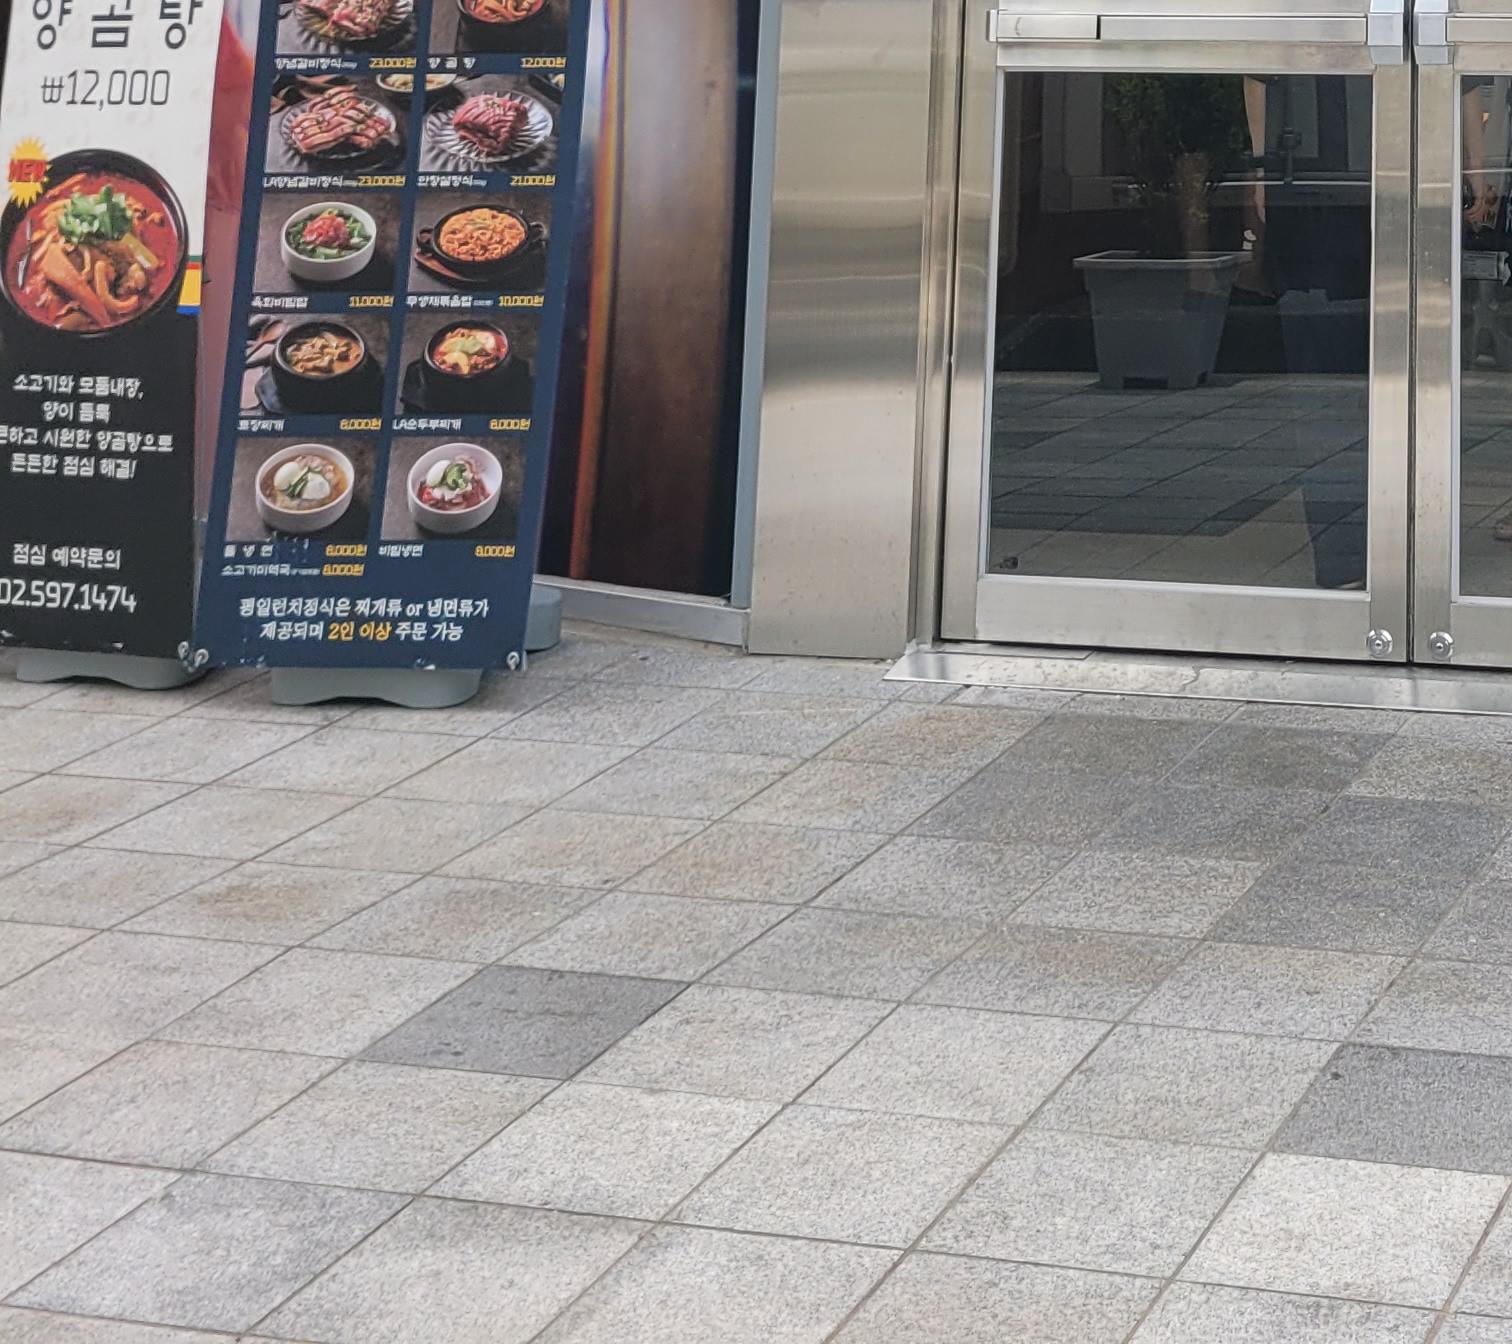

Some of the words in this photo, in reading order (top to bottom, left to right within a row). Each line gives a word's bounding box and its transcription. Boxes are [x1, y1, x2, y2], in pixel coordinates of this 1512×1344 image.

[13, 374, 75, 394] 소고기와
[42, 400, 74, 421] 양이
[42, 427, 92, 449] 시원한
[96, 431, 174, 453] 양곰탕으로
[11, 453, 59, 474] 든든한
[62, 456, 95, 477] 점심
[99, 458, 137, 480] 해결!
[13, 543, 47, 566] 점심
[51, 545, 122, 570] 예약문의
[0, 578, 137, 613] 02.597.1474
[239, 598, 351, 617] 평일런치정식은
[354, 598, 402, 616] 찌개류
[406, 603, 423, 616] or
[427, 598, 489, 618] 냉면류가
[260, 622, 322, 641] 제공되며
[328, 622, 355, 640] 2인
[358, 622, 392, 640] 이상
[395, 622, 428, 641] 주문
[430, 622, 463, 641] 가능
